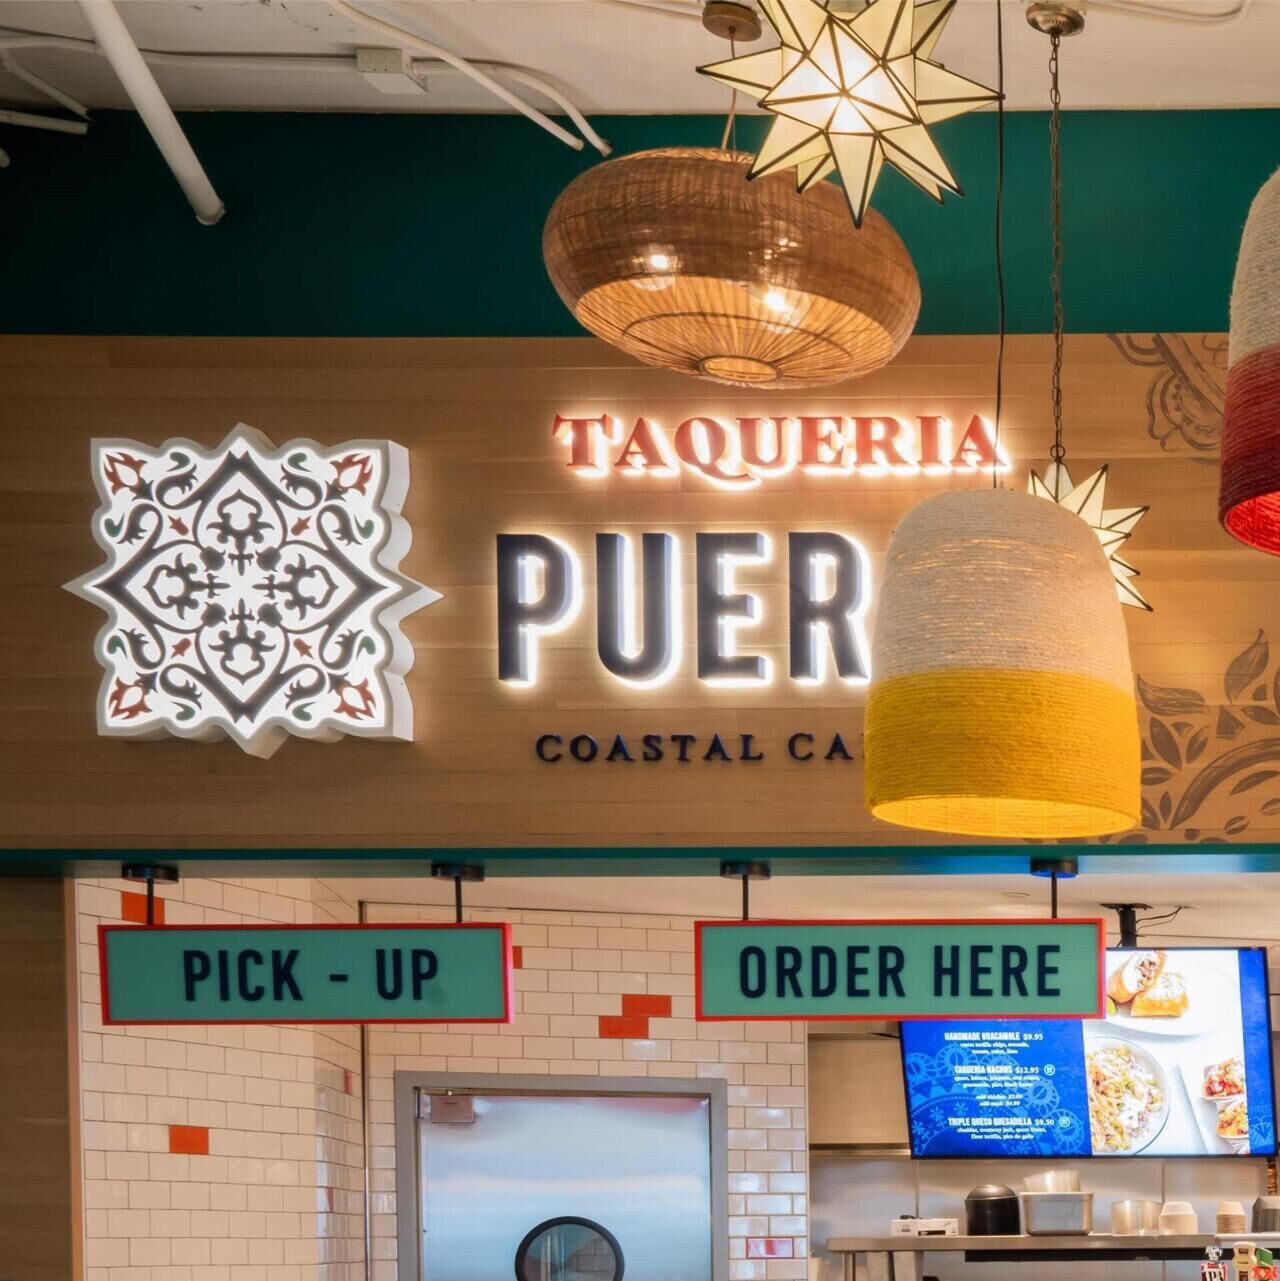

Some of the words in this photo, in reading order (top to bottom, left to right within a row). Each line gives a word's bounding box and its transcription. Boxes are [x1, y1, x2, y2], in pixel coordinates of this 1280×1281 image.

[552, 414, 1010, 484] TAQUERIA
[497, 532, 868, 683] PUER
[535, 733, 764, 762] COASTAL
[183, 949, 303, 1001] PICK
[376, 949, 439, 1001] UP
[739, 943, 906, 999] ORDER
[933, 943, 1062, 998] HERE
